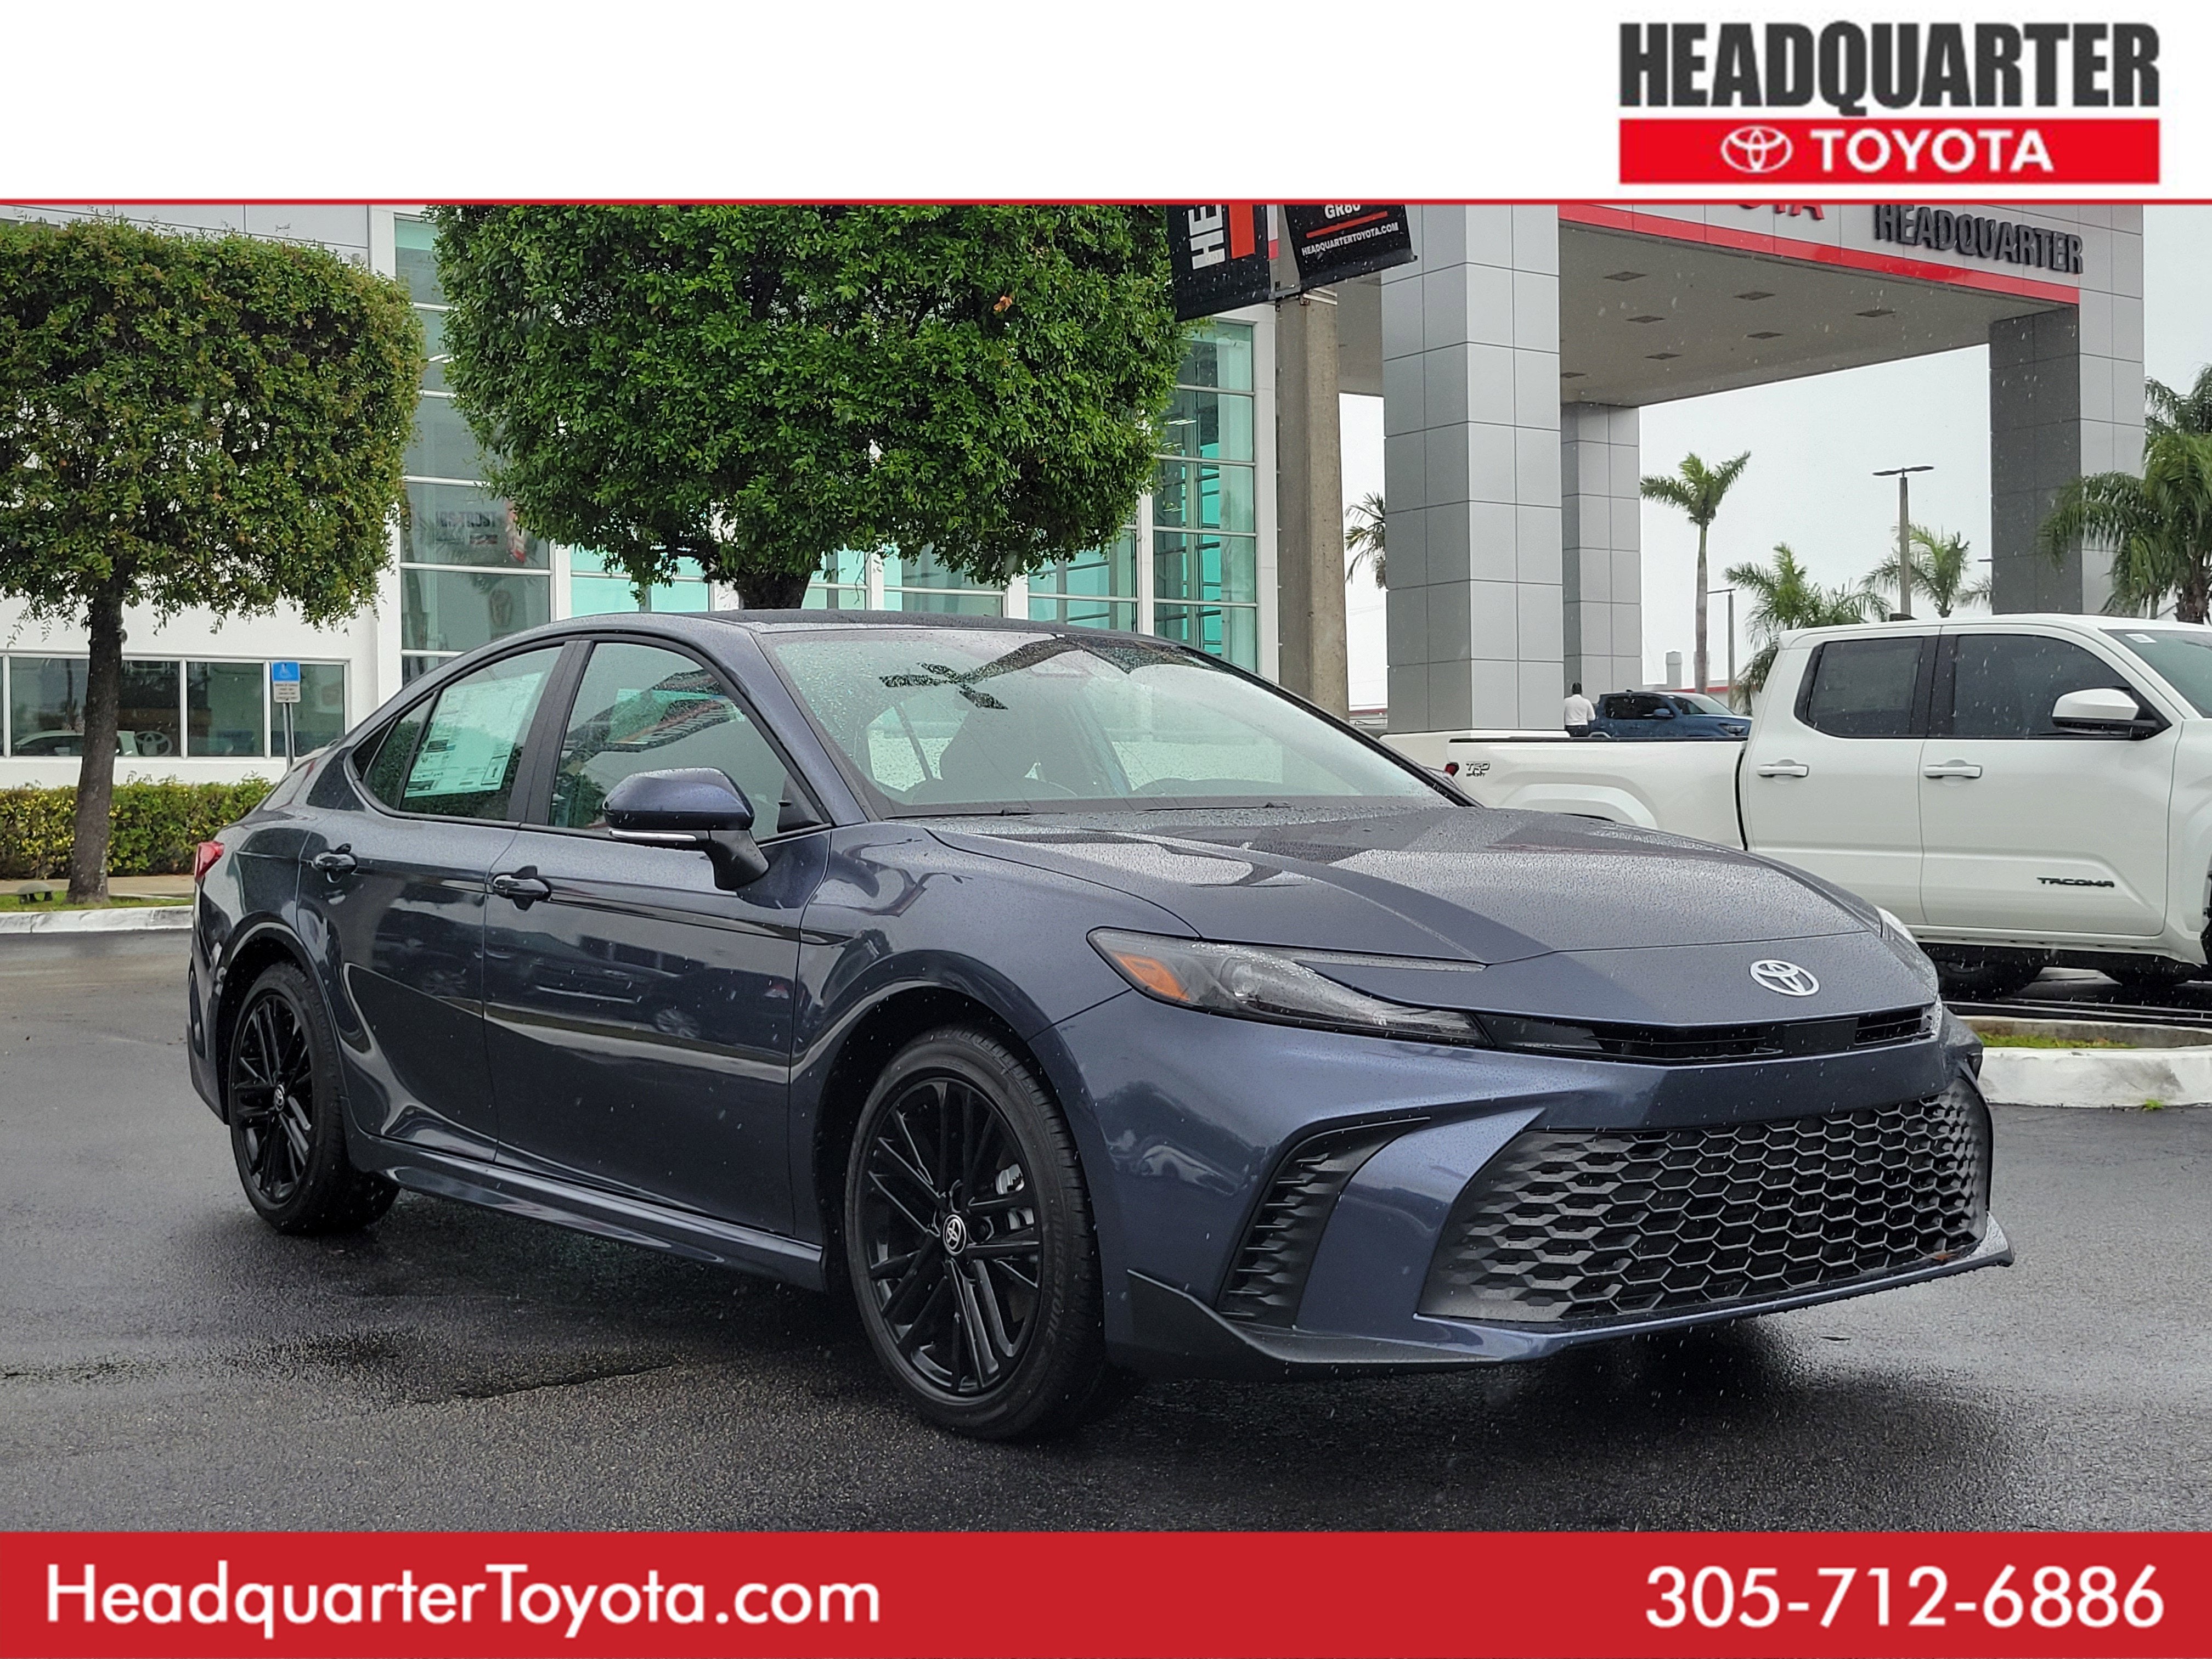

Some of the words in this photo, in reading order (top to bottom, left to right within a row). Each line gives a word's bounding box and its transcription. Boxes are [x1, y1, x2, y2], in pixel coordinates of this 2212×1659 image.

[1301, 222, 1400, 256] HEADQUARTERTOYOTA.COM
[1874, 205, 2084, 274] HEADQUARTER
[2036, 877, 2115, 888] TACOMA
